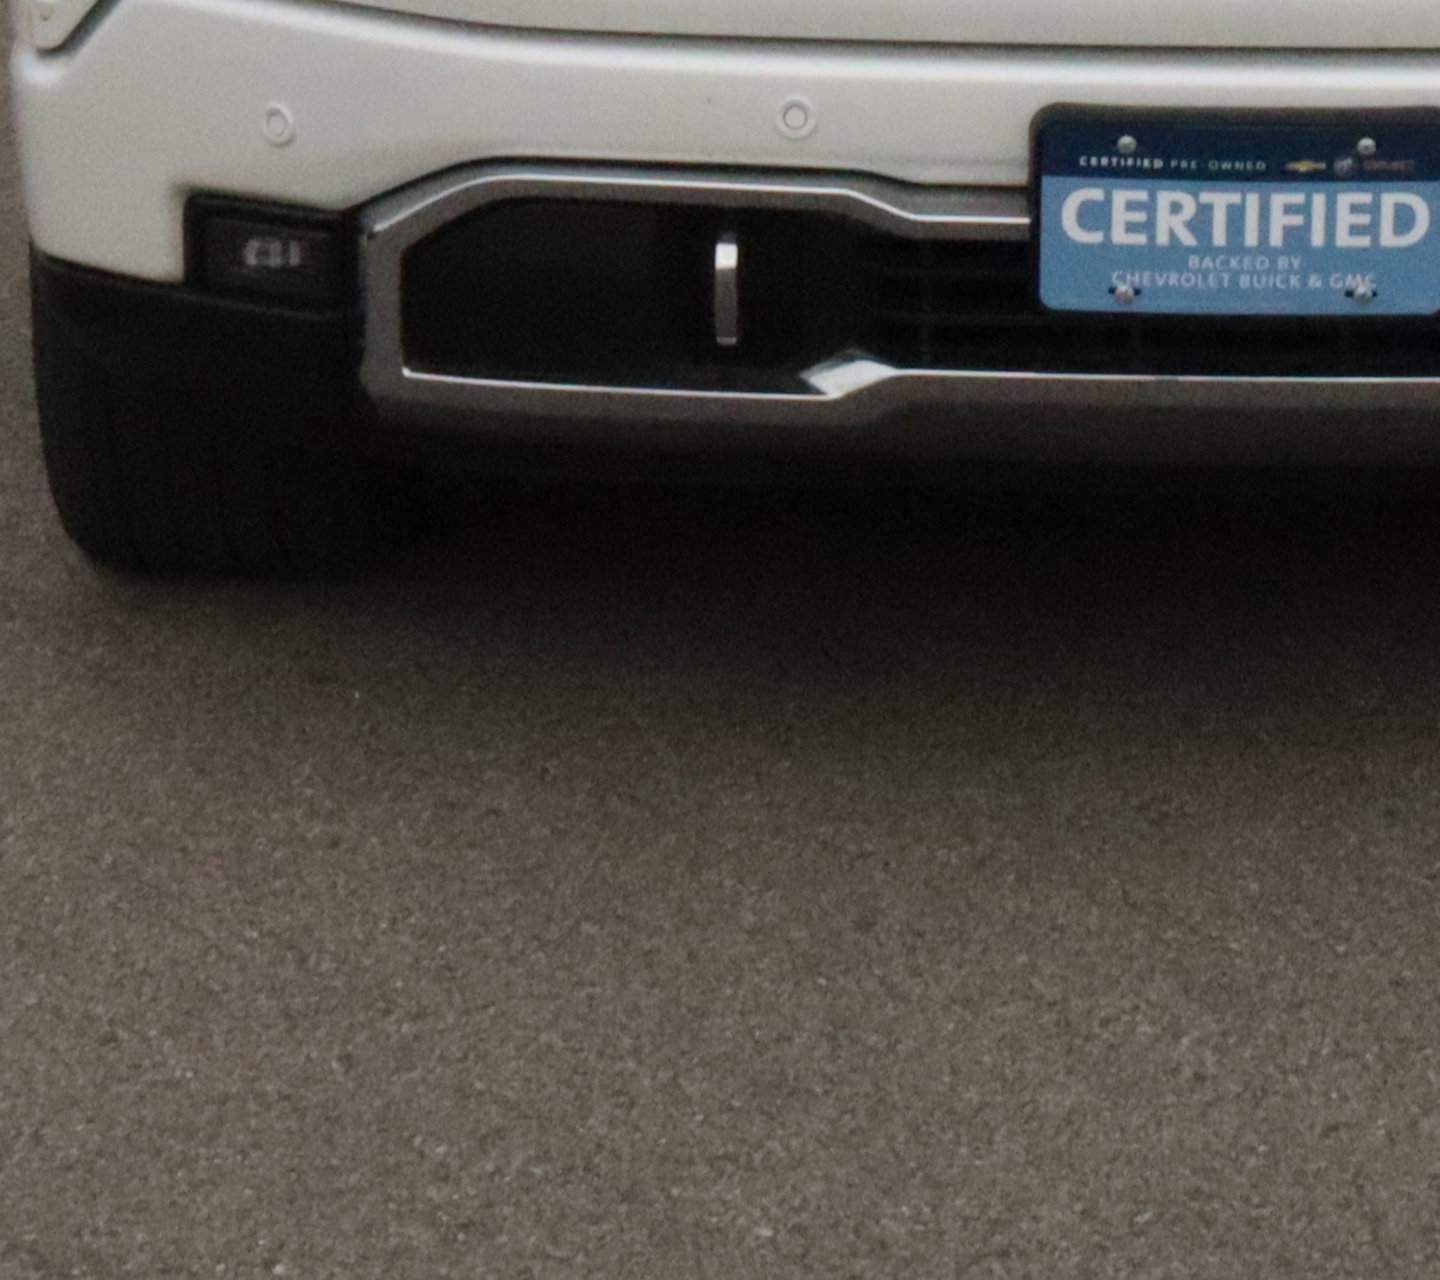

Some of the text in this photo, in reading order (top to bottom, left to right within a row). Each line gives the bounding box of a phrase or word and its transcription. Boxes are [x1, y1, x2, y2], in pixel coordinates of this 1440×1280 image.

[1079, 155, 1267, 171] CERTIFIED PRE OWNED
[1062, 187, 1430, 248] CERTIFIED
[1188, 255, 1302, 270] BACKED BY
[1112, 271, 1378, 290] CHEVROLET BUICK & GMC
